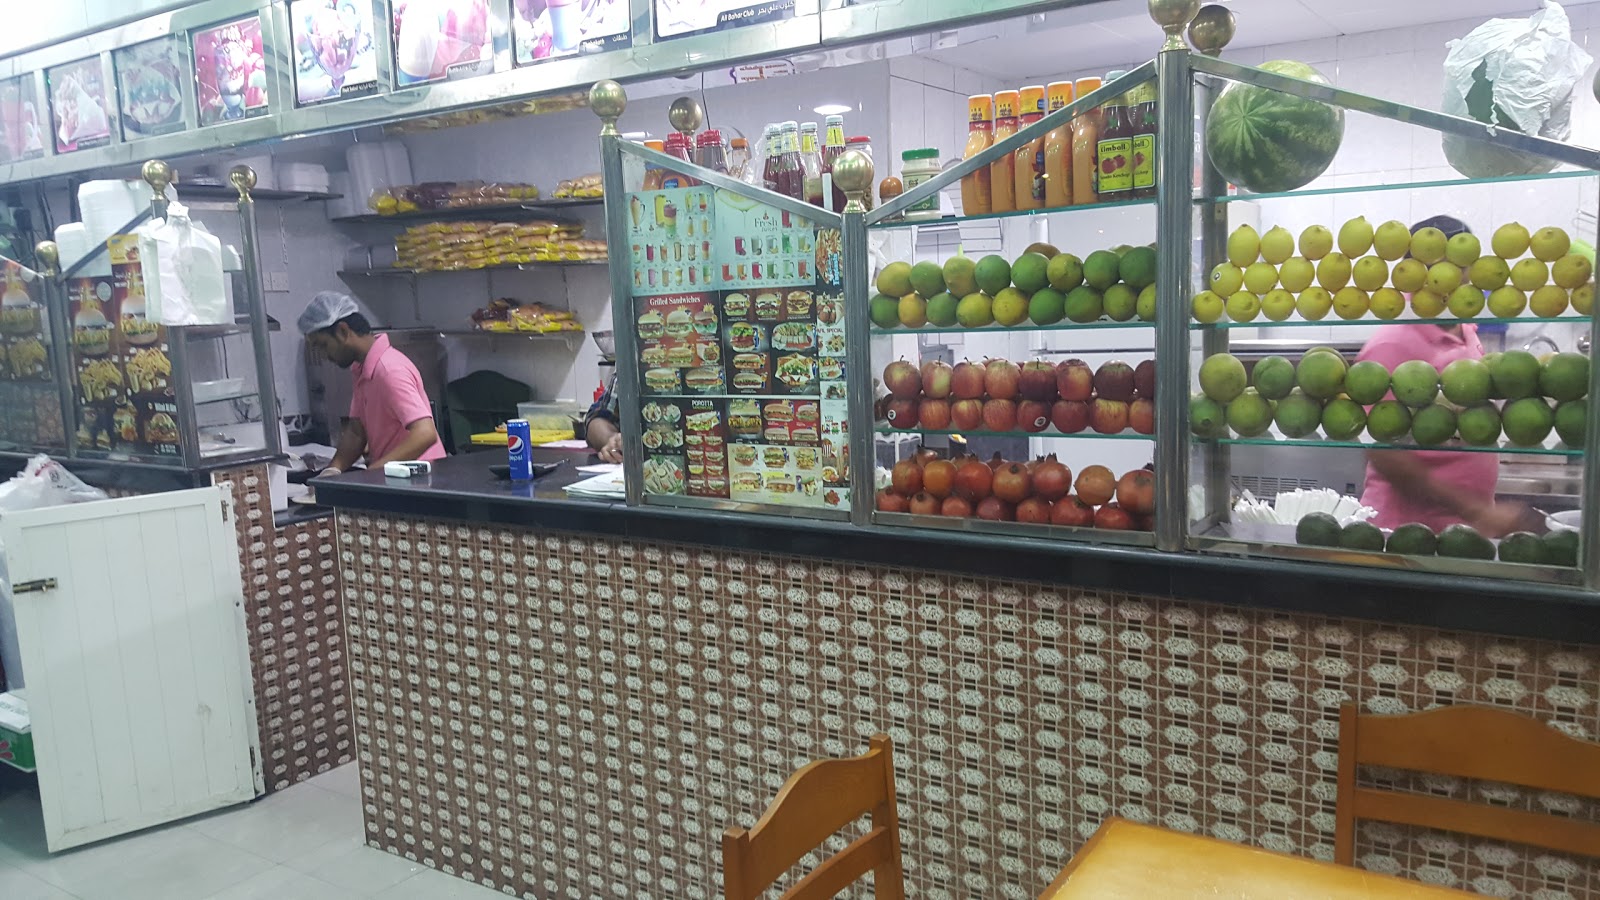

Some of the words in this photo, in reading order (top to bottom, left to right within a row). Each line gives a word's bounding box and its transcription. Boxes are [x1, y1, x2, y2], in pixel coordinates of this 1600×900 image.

[742, 10, 755, 18] Club
[754, 217, 778, 228] Fresh
[649, 298, 668, 306] Grilled
[668, 295, 701, 305] Sandwiches
